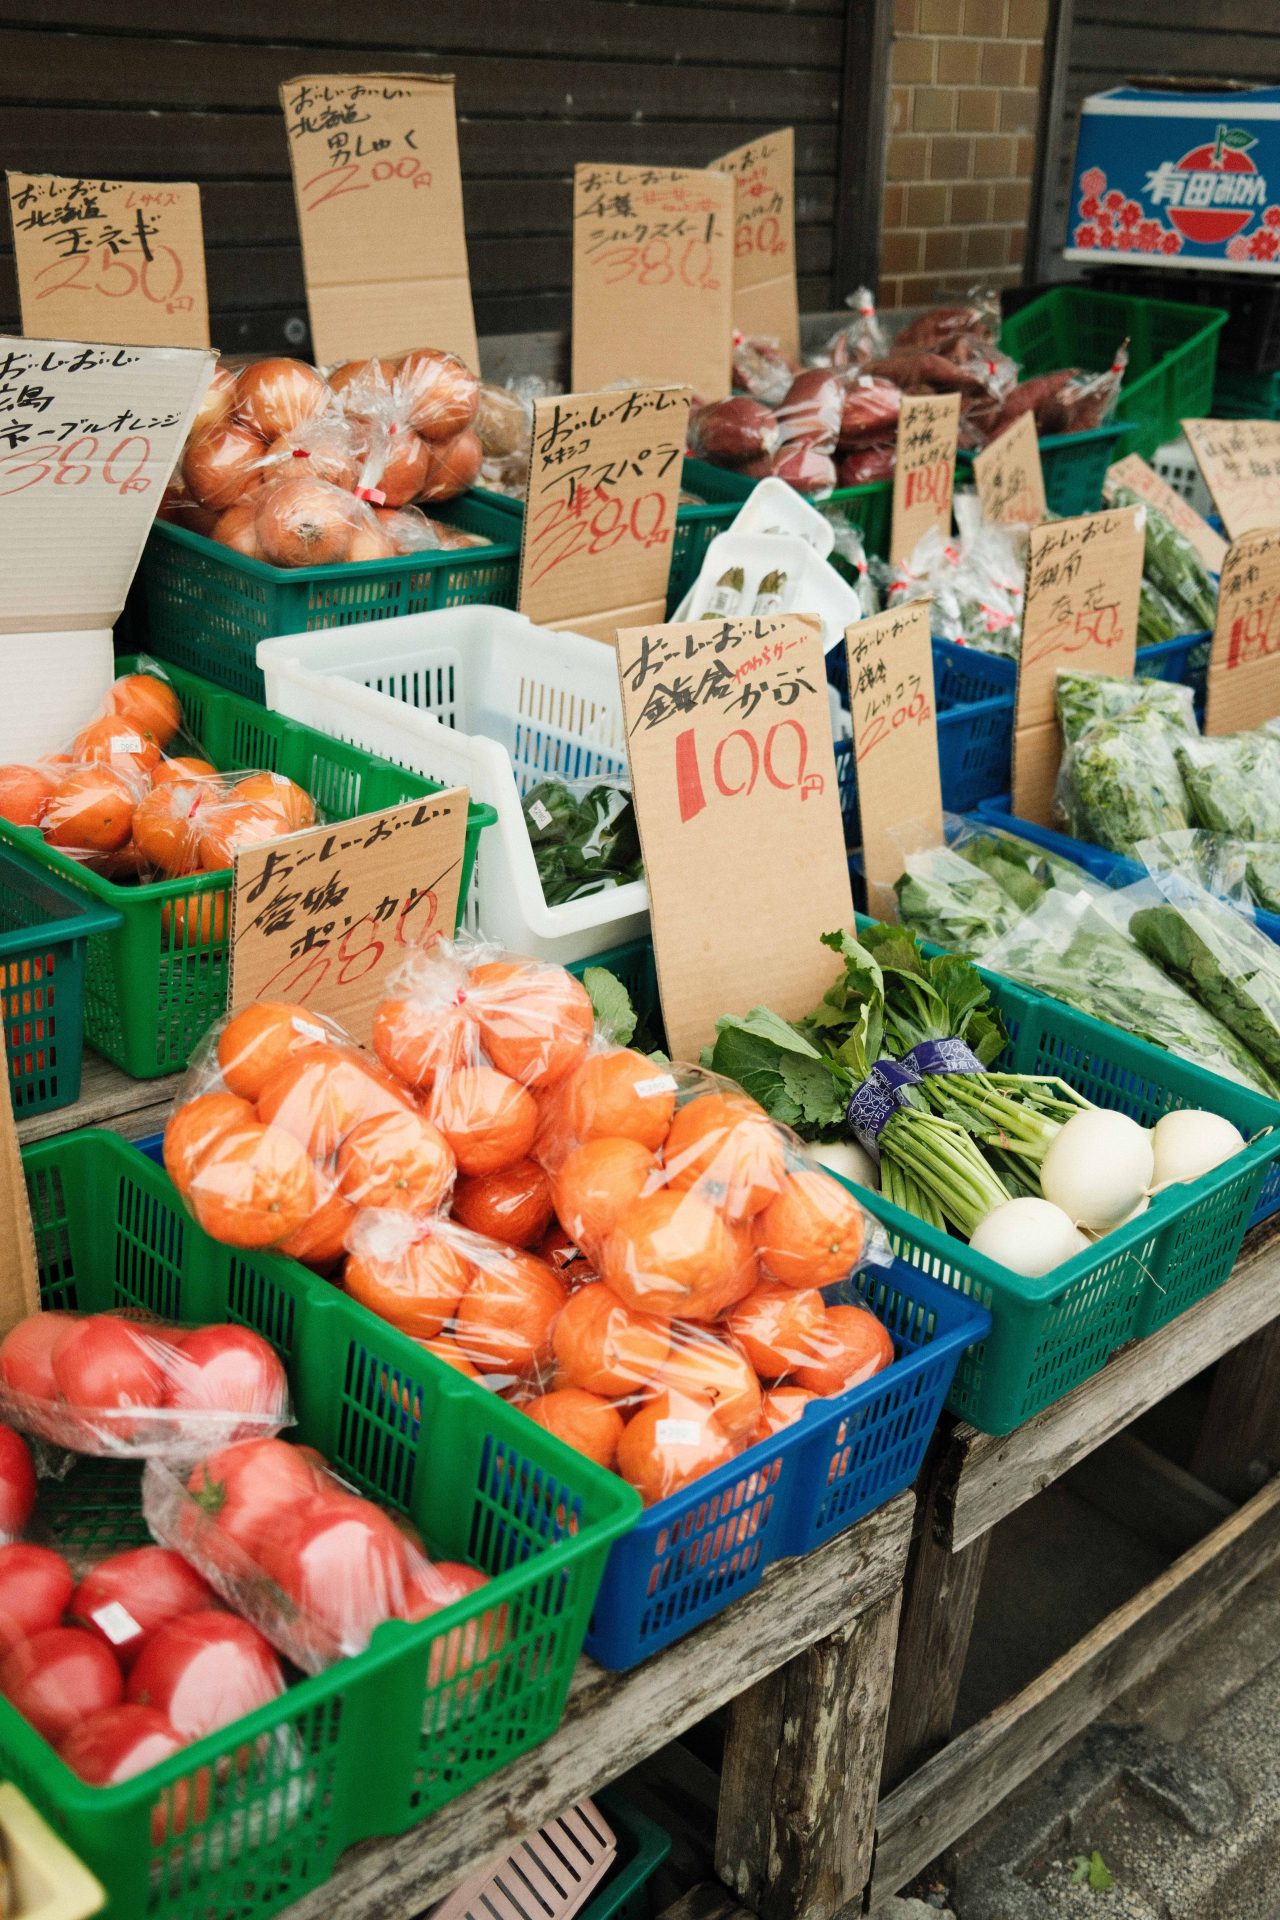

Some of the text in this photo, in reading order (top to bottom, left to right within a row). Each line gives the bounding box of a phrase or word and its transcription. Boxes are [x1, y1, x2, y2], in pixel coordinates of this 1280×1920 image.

[289, 103, 372, 139] 北海道
[302, 157, 433, 212] 200円
[16, 196, 108, 231] 北海道
[42, 208, 161, 262] 玉ネギ
[34, 244, 194, 315] 250円
[590, 238, 722, 290] 380円
[0, 409, 181, 449] ネーブルオレンジ
[541, 439, 591, 472] メキシコ
[0, 436, 151, 496] 380円
[540, 443, 680, 507] アスパラ
[529, 492, 671, 588] 280円
[1022, 605, 1124, 668] 250円
[629, 659, 737, 737] 鎌倉
[864, 674, 921, 722] ルッコラ
[857, 693, 931, 763] 200円
[675, 719, 825, 824] 100円
